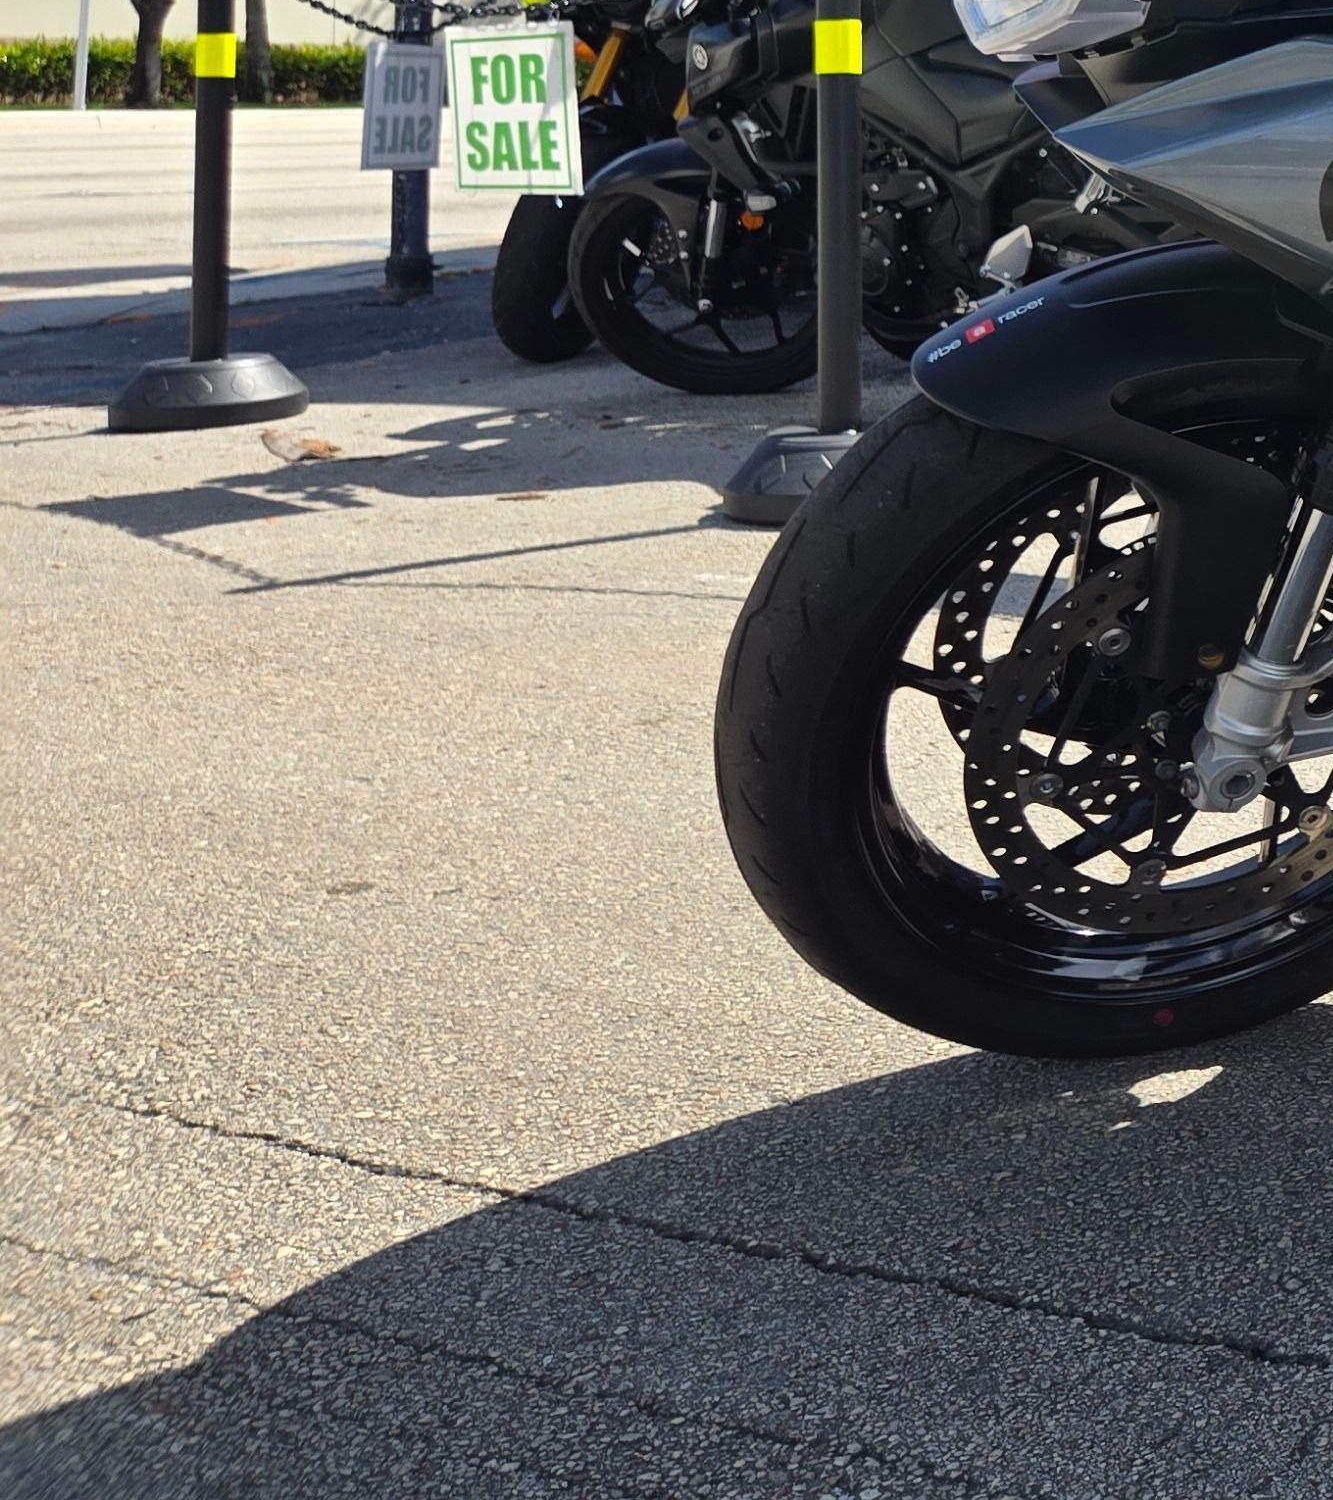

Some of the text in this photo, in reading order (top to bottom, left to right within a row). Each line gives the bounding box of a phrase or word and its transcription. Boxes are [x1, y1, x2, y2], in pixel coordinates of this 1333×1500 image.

[470, 53, 546, 105] FOR
[466, 120, 561, 172] SALE
[927, 338, 962, 363] #be
[998, 297, 1045, 324] racer
